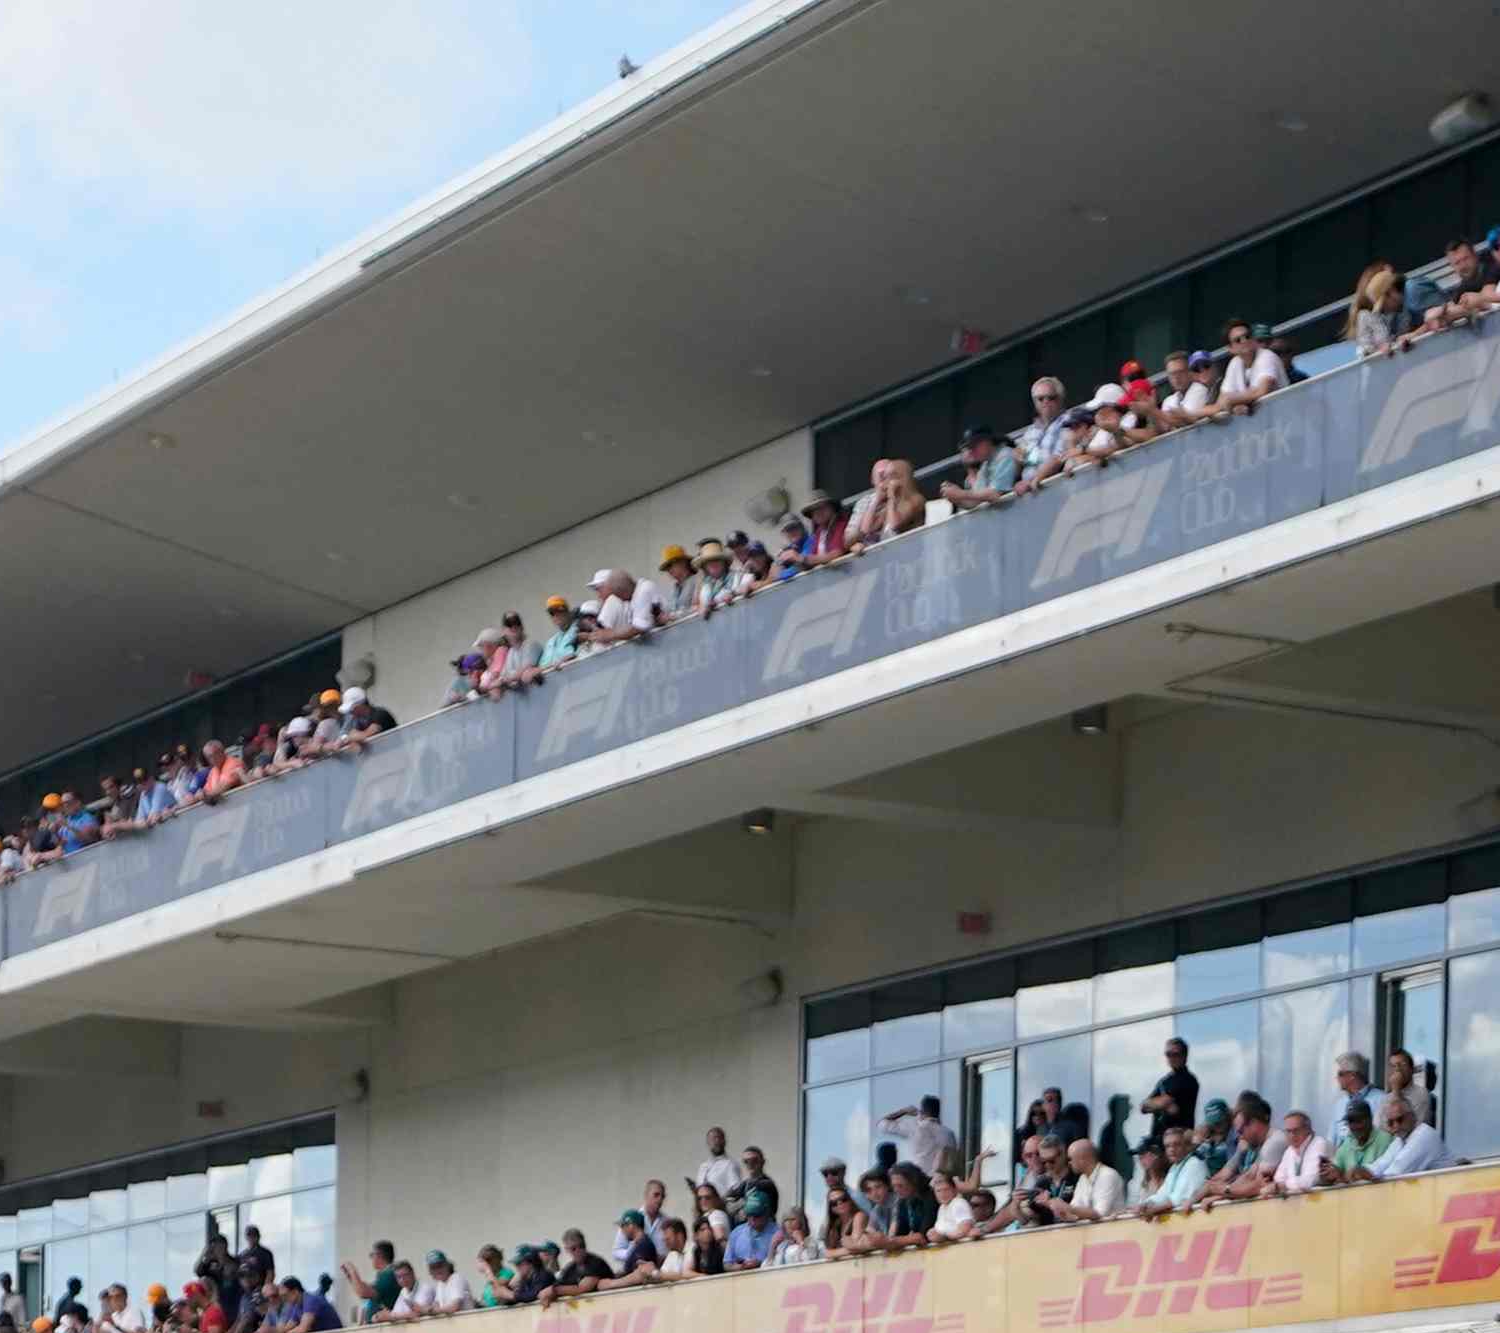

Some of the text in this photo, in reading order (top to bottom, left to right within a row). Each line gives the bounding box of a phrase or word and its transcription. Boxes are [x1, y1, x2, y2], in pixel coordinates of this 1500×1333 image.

[1028, 459, 1172, 590] F1
[761, 568, 880, 680] F1
[1075, 1225, 1262, 1322] DHL
